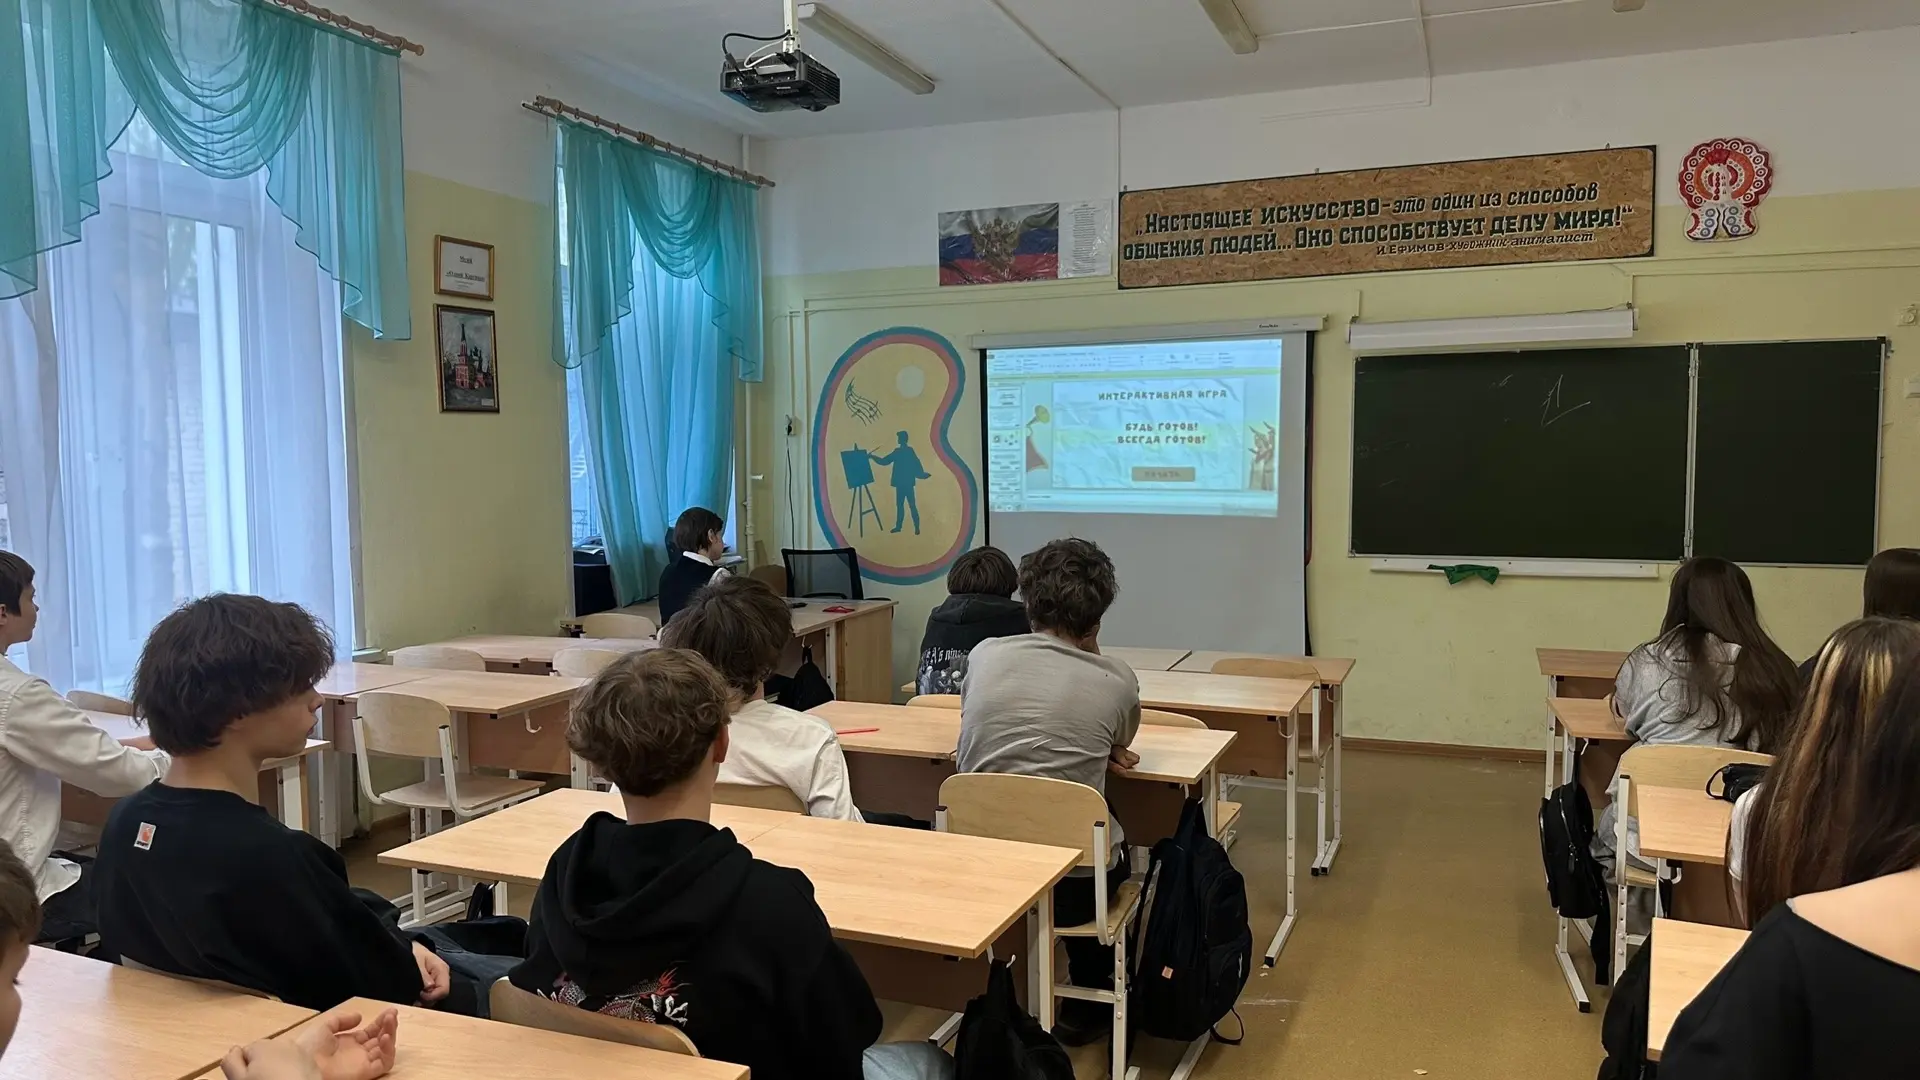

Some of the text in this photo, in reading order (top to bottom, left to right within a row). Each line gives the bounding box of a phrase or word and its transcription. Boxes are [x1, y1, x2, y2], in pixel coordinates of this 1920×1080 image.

[1431, 192, 1475, 211] один
[1479, 192, 1501, 208] из
[1506, 182, 1599, 206] способов
[1123, 238, 1205, 260] ОБЩЕНИЯ
[1339, 217, 1485, 245] СПОСОБСТВУЕТ
[1489, 212, 1550, 237] ДЕЛУ
[1098, 389, 1227, 401] ИНТЕРАКТИВНАЯ ИГРА
[1125, 421, 1199, 432] БУДЬ ГОТОВ!
[1117, 434, 1207, 445] ВСЕГДА ГОТОВ!
